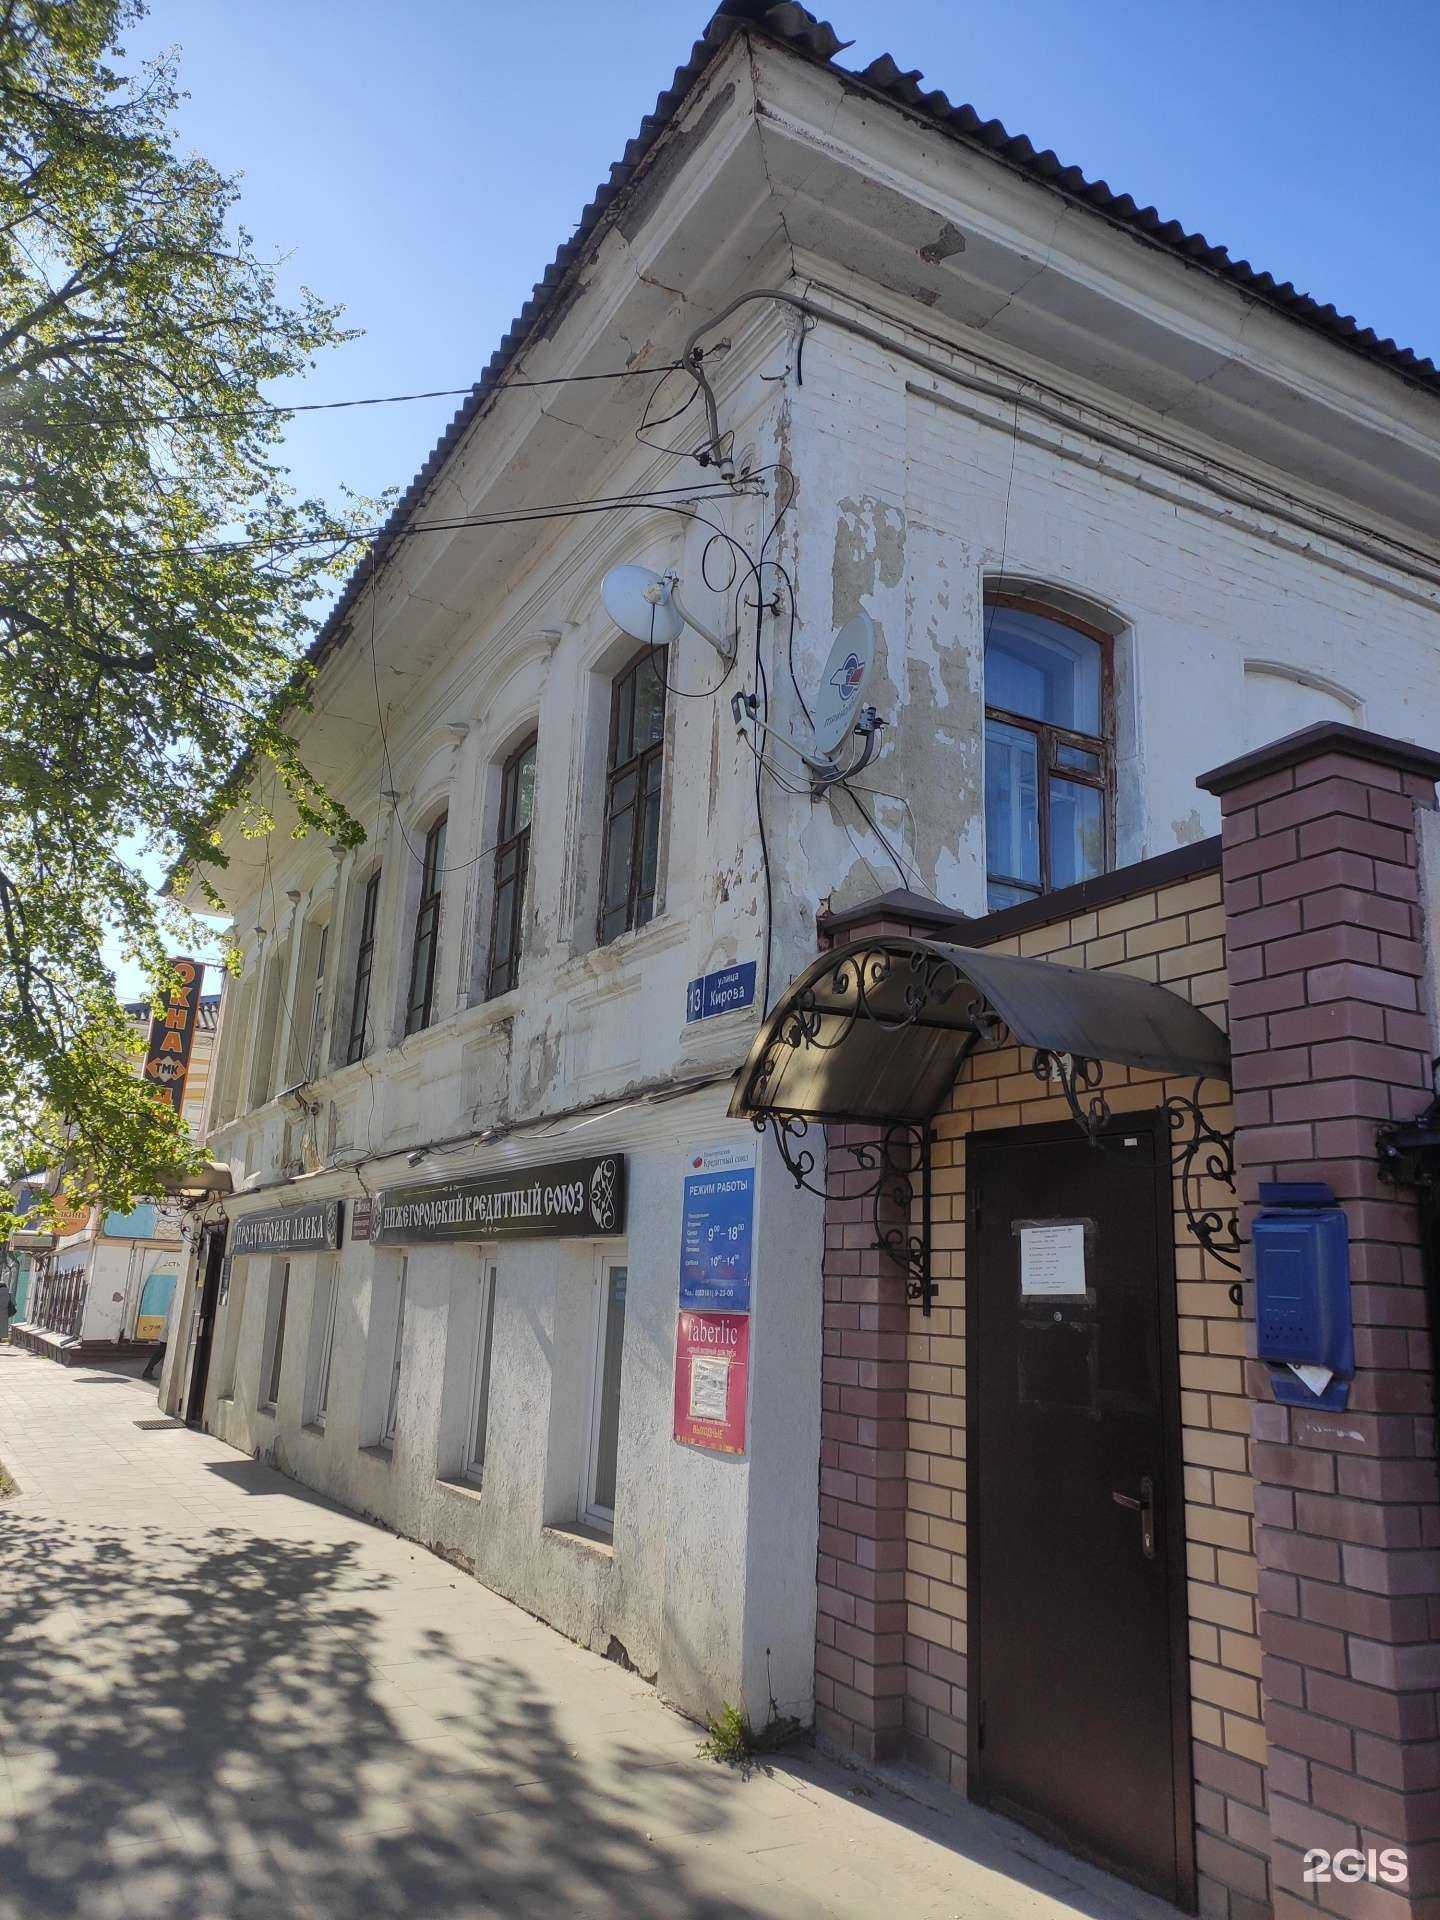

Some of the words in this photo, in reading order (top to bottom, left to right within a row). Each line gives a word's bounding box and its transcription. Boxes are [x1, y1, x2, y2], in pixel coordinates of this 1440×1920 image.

[717, 972, 739, 988] улица
[160, 962, 196, 1053] ОКНА
[689, 988, 701, 1013] 13
[710, 986, 745, 1007] Кирова
[155, 1062, 179, 1076] ТМК
[689, 1184, 715, 1196] РЕЖИМ
[717, 1180, 748, 1193] РАБОТЫ
[384, 1192, 463, 1230] НИЖЕГОРОДСКИЙ
[465, 1182, 542, 1225] КРЕДИТНЫЙ
[543, 1181, 584, 1216] СОЮЗ
[236, 1219, 291, 1249] ПРОДУКТОВАЯ
[292, 1215, 324, 1241] ЛАВКА
[687, 1318, 738, 1345] faberlic
